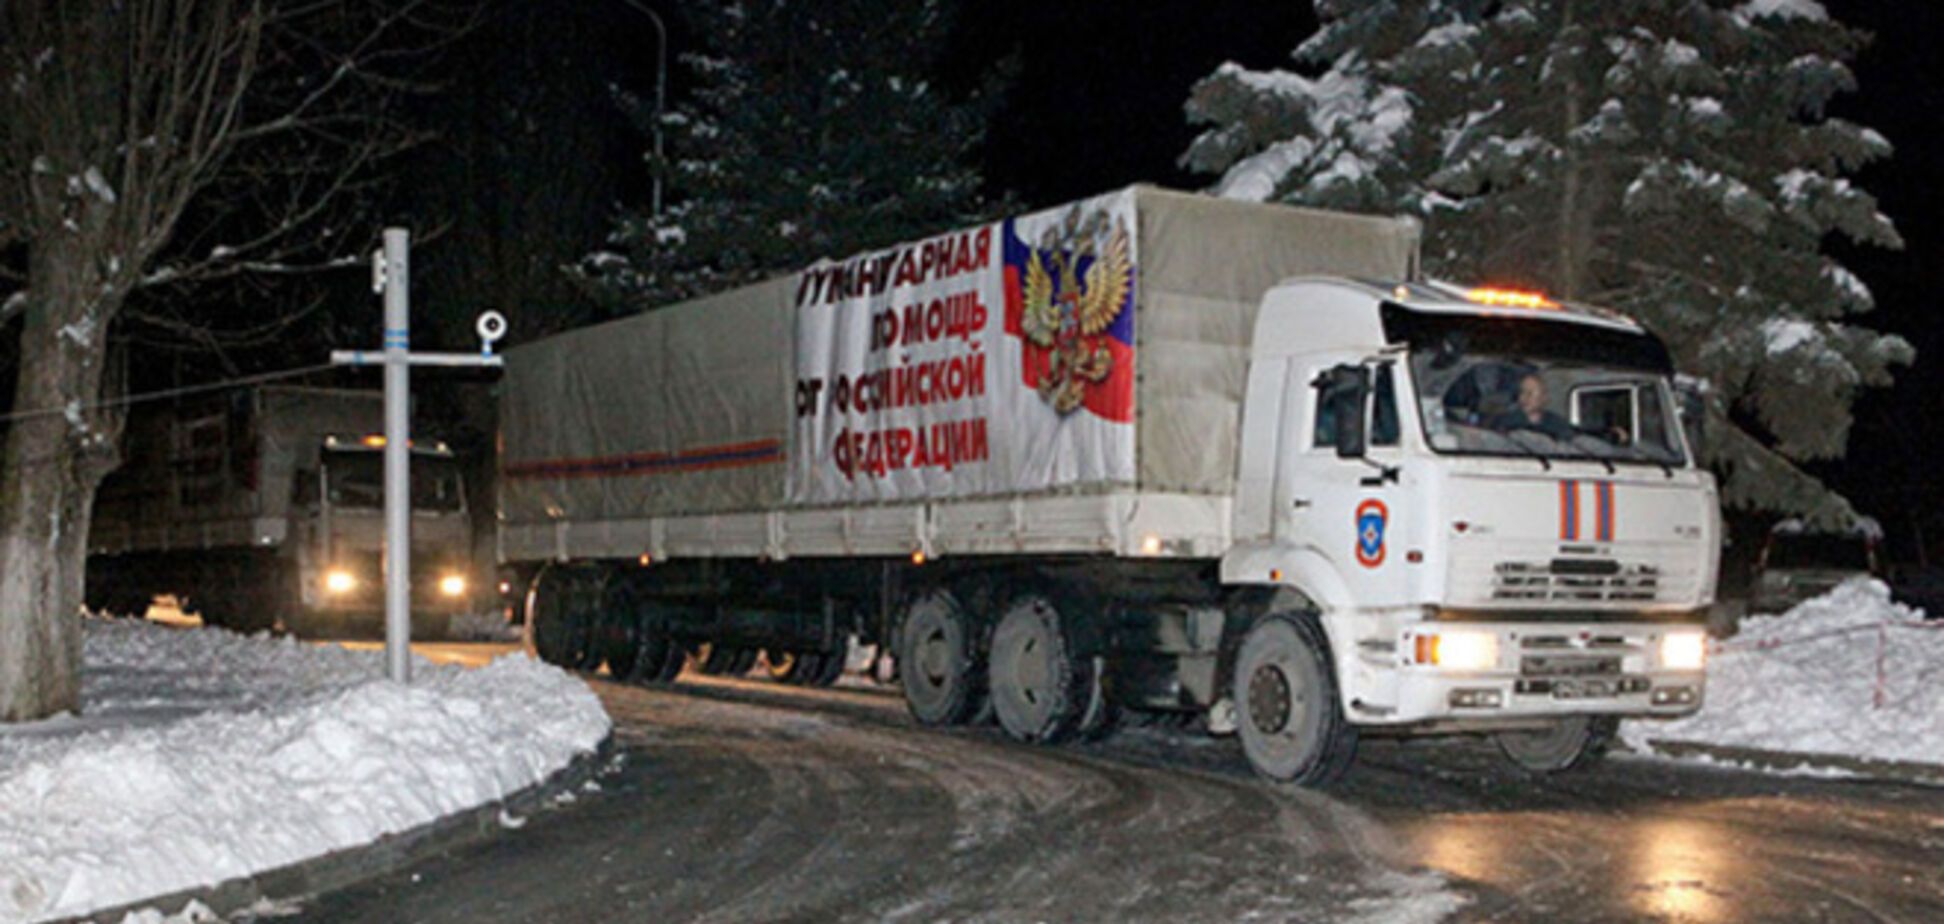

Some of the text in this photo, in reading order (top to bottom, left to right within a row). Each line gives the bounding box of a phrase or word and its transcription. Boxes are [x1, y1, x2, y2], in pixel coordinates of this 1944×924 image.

[796, 225, 991, 307] ГУМНТАРНАЯ
[829, 341, 986, 415] ОССИЙСКОЙ
[834, 416, 990, 482] ФЕДЕРАЦИИ
